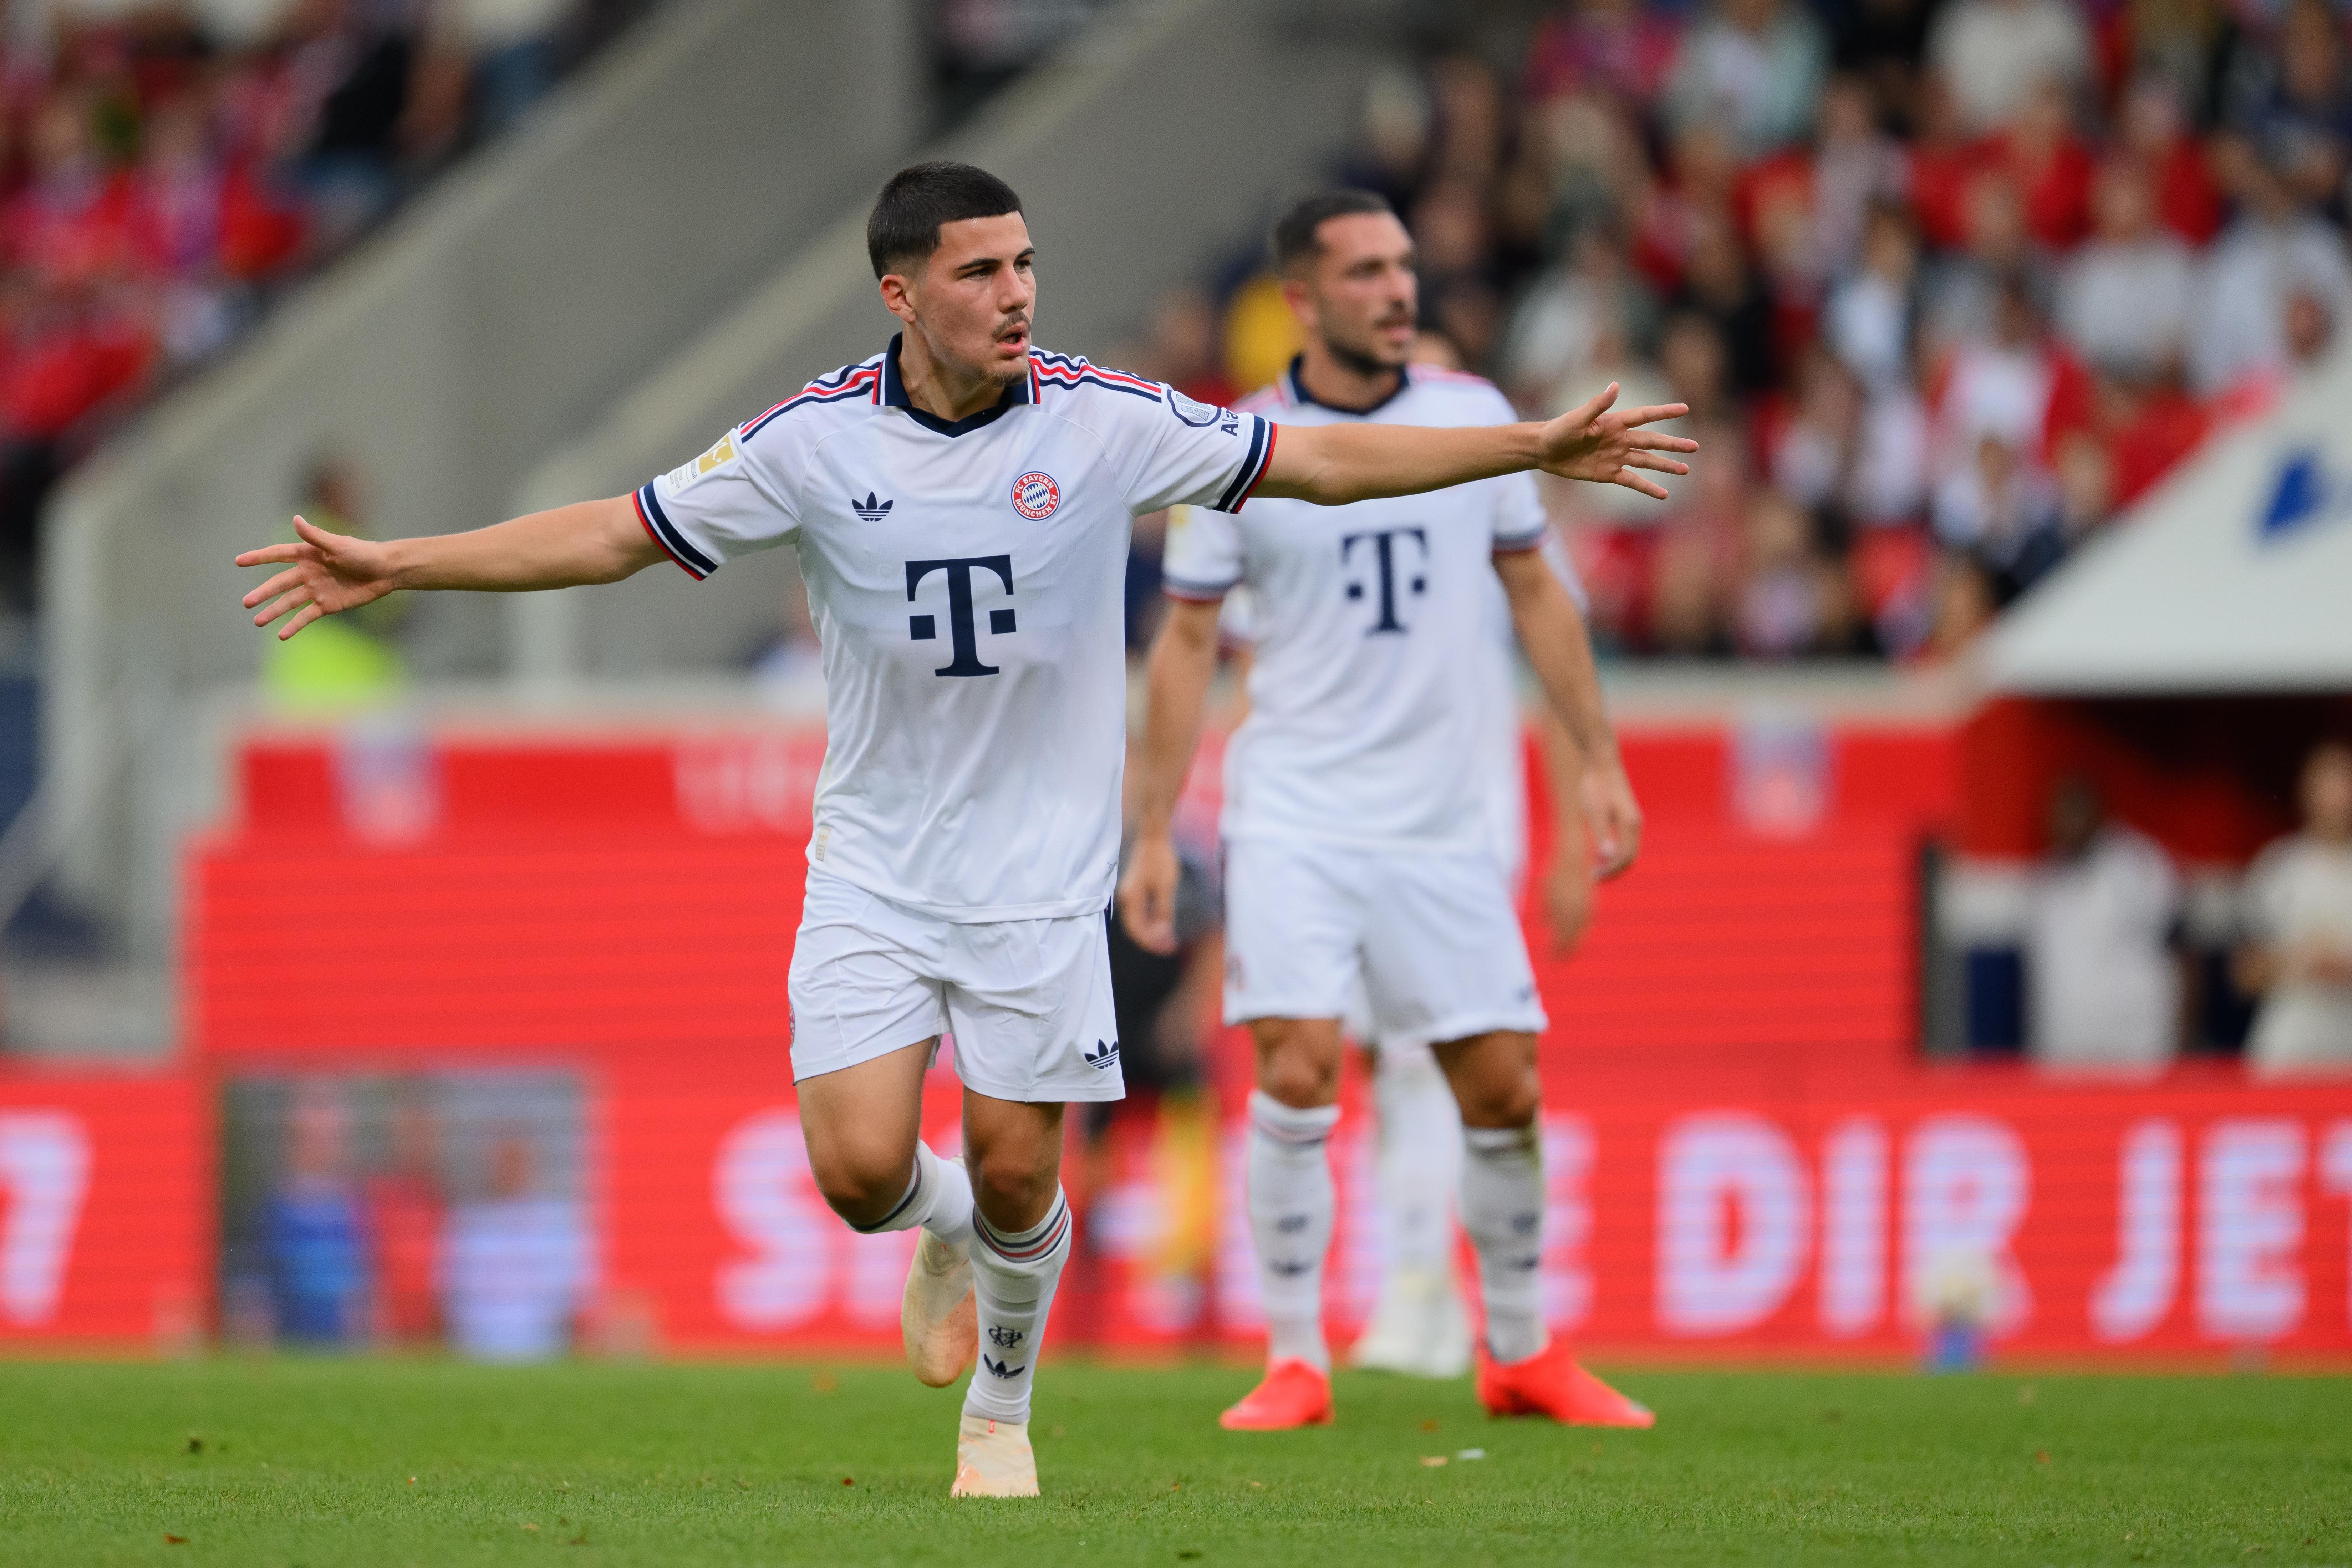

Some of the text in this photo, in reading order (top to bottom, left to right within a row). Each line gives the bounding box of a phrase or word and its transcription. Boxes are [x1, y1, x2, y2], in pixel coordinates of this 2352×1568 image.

[1015, 475, 1053, 493] FC BAYERN
[905, 554, 1016, 676] T
[1340, 526, 1429, 638] T
[1658, 1111, 2031, 1338] DIR
